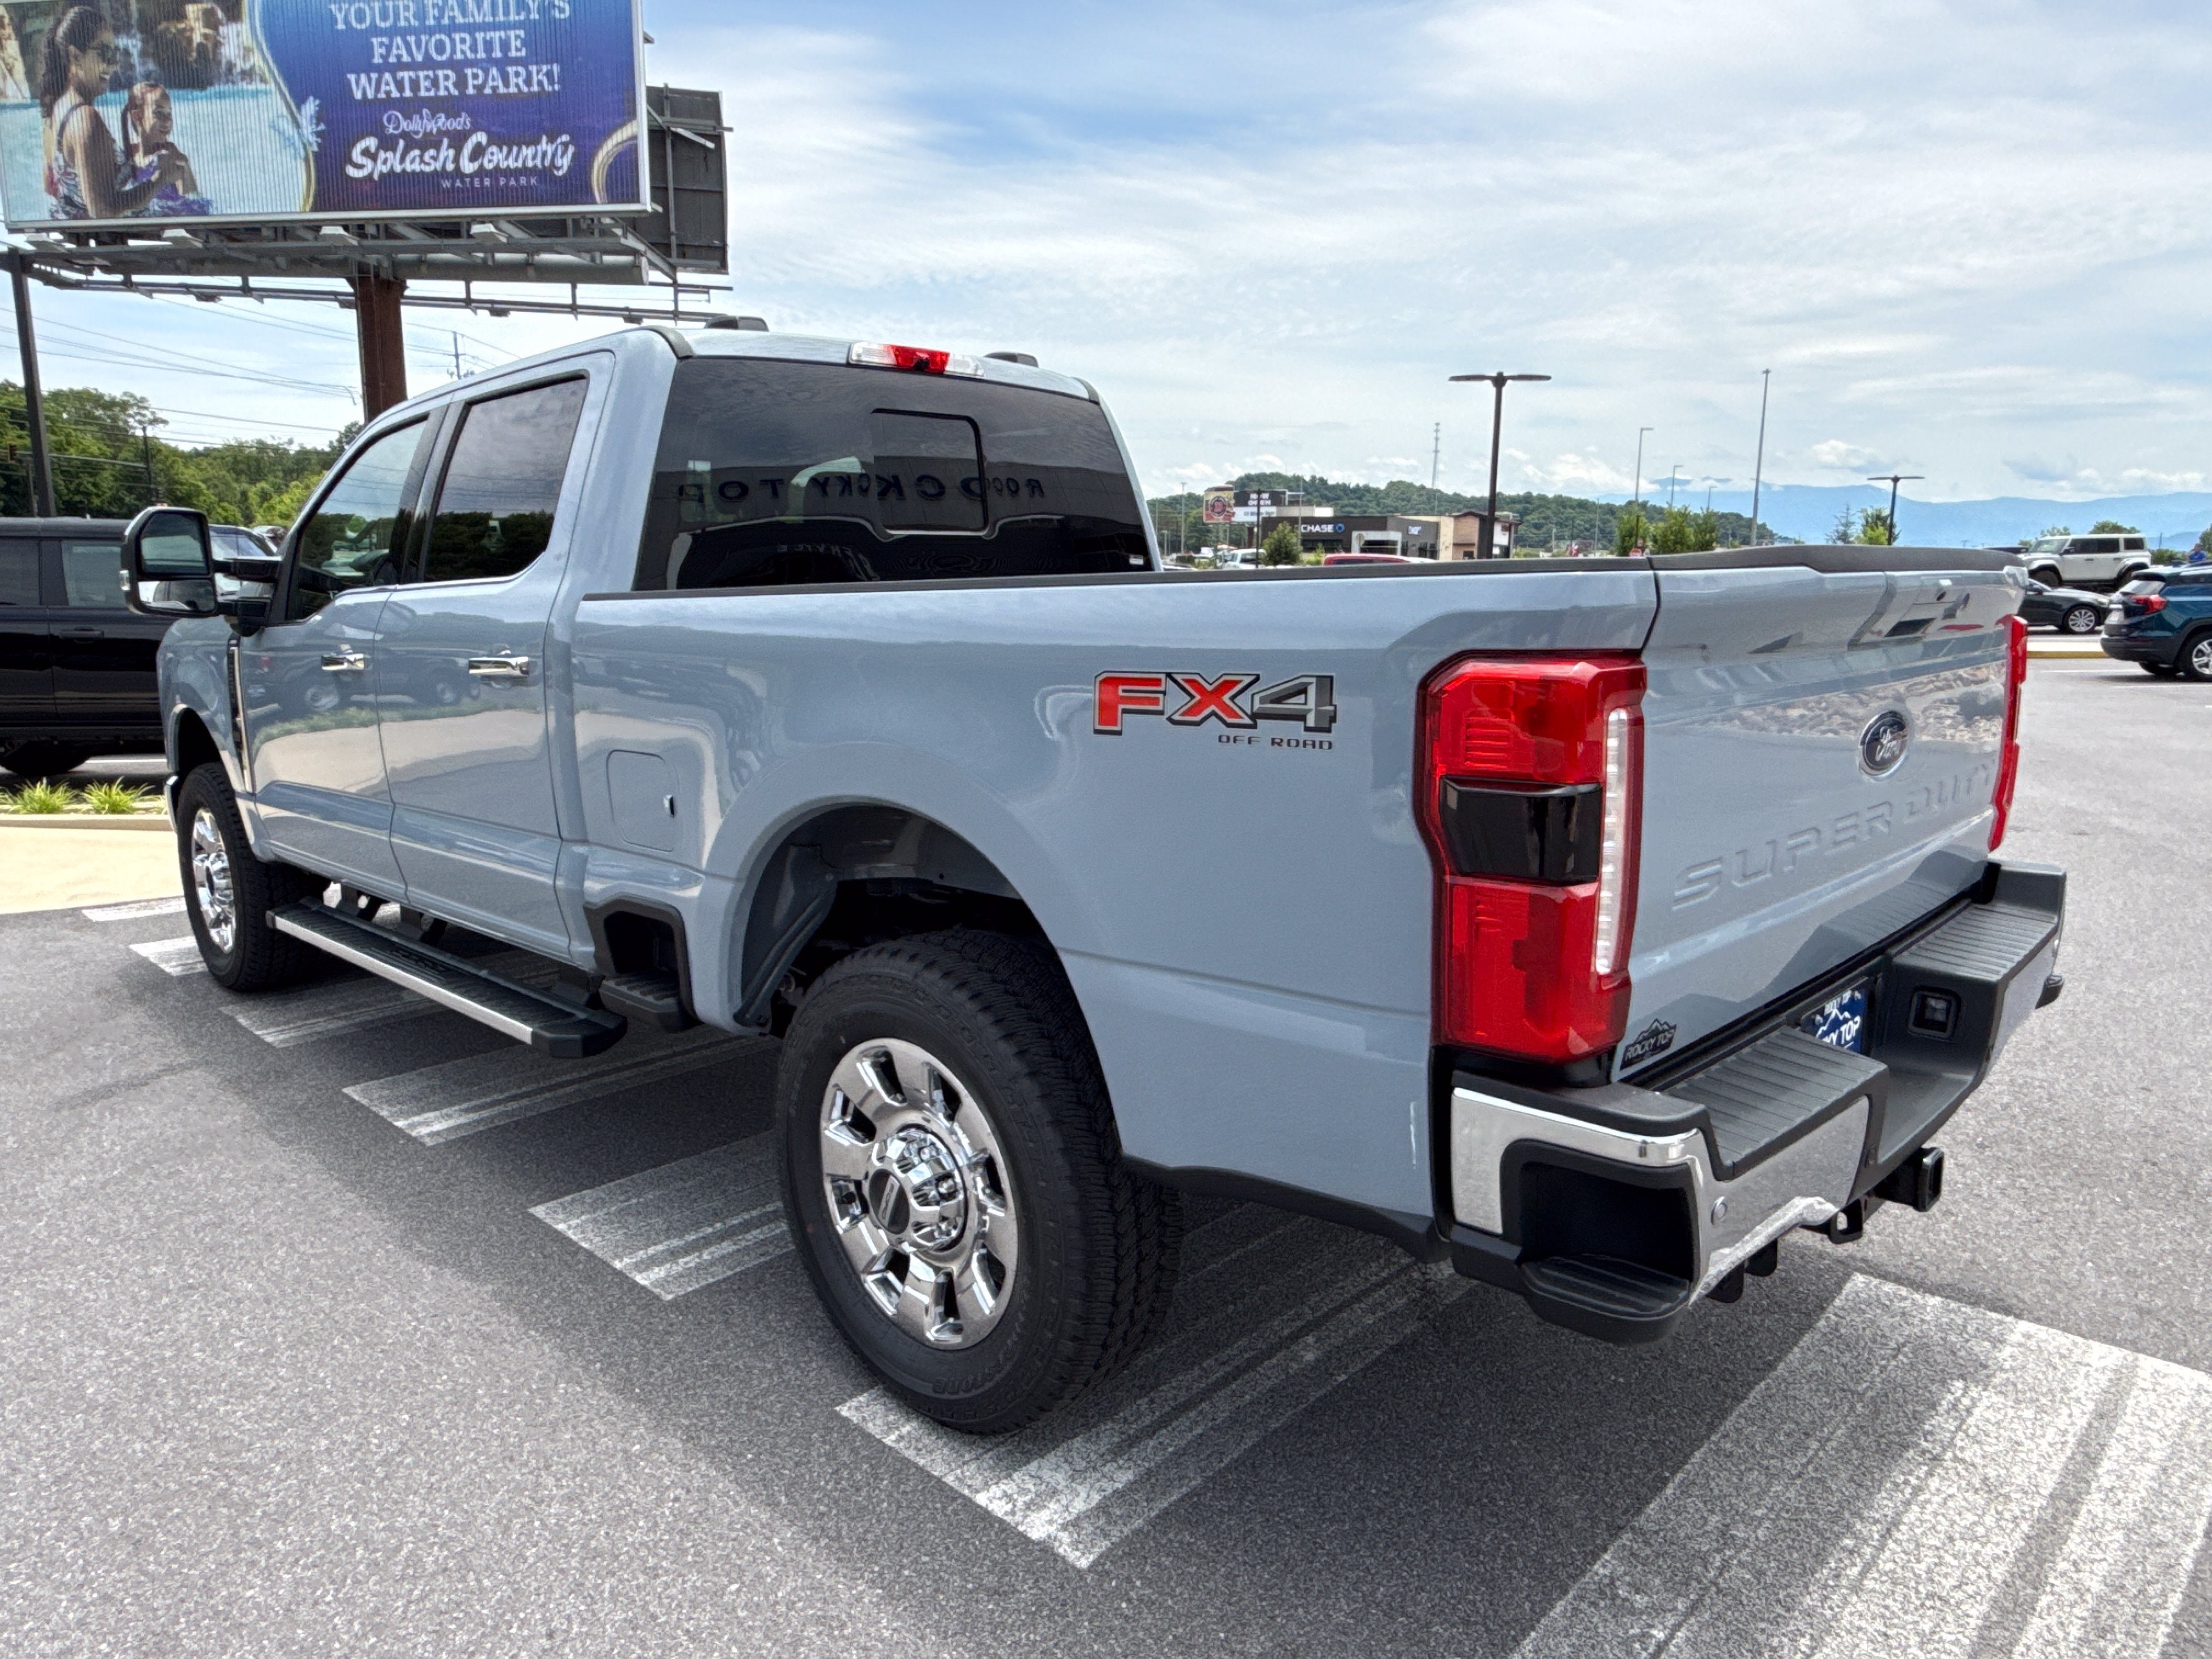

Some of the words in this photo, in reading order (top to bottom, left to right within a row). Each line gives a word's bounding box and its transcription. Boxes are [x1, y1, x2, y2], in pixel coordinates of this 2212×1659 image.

[329, 0, 419, 30] YOUR
[370, 30, 527, 64] FAVORITE
[347, 69, 459, 100] WATER
[464, 64, 561, 95] PARK!
[345, 136, 456, 181] Splash
[459, 131, 575, 177] Country
[441, 177, 490, 189] WATER
[500, 176, 539, 188] PARK
[1301, 524, 1334, 533] CHASE
[1093, 670, 1337, 736] FX4
[1218, 734, 1261, 746] OFF
[1271, 737, 1333, 751] ROAD
[1671, 800, 1894, 912] SUPER
[1840, 1015, 1861, 1045] TOP
[1624, 1036, 1656, 1061] ROCKY
